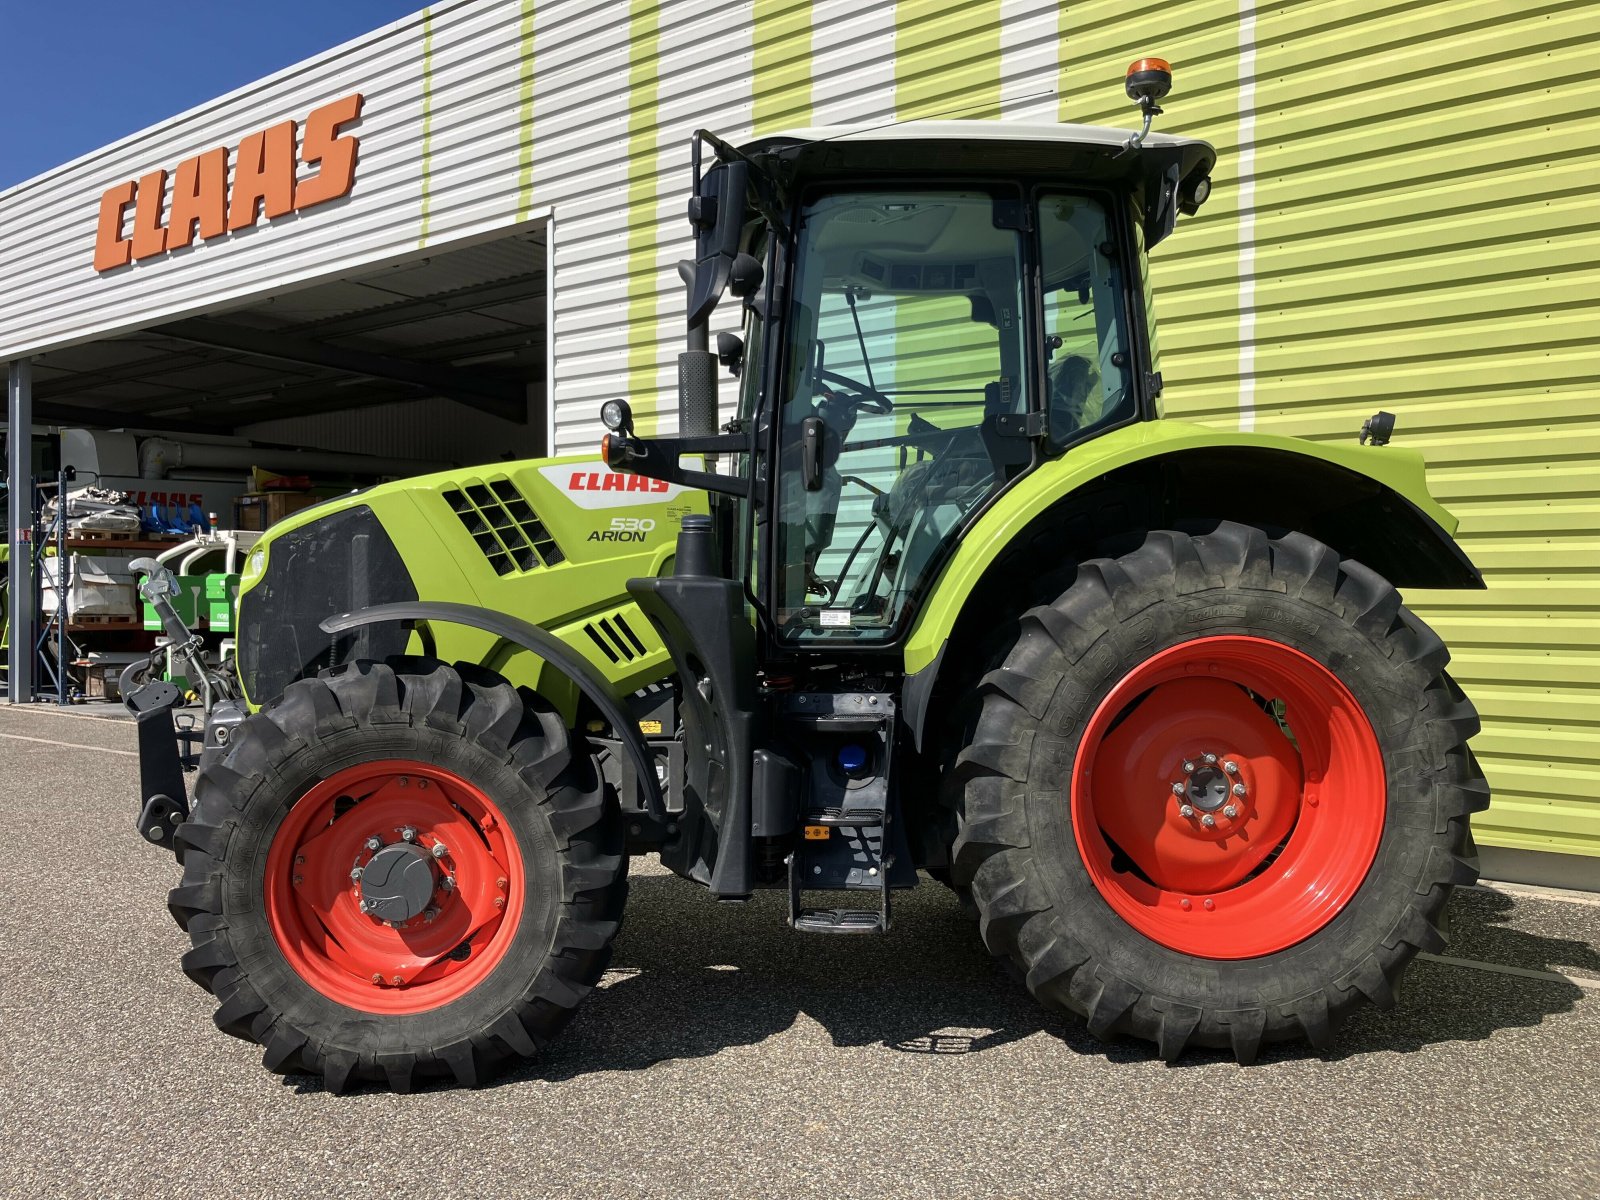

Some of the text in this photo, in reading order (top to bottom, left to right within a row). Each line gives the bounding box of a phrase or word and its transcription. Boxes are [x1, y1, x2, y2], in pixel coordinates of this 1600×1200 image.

[93, 93, 363, 272] CLAAS
[569, 472, 669, 493] CLAAS
[609, 517, 656, 532] 530
[587, 530, 646, 542] ARION
